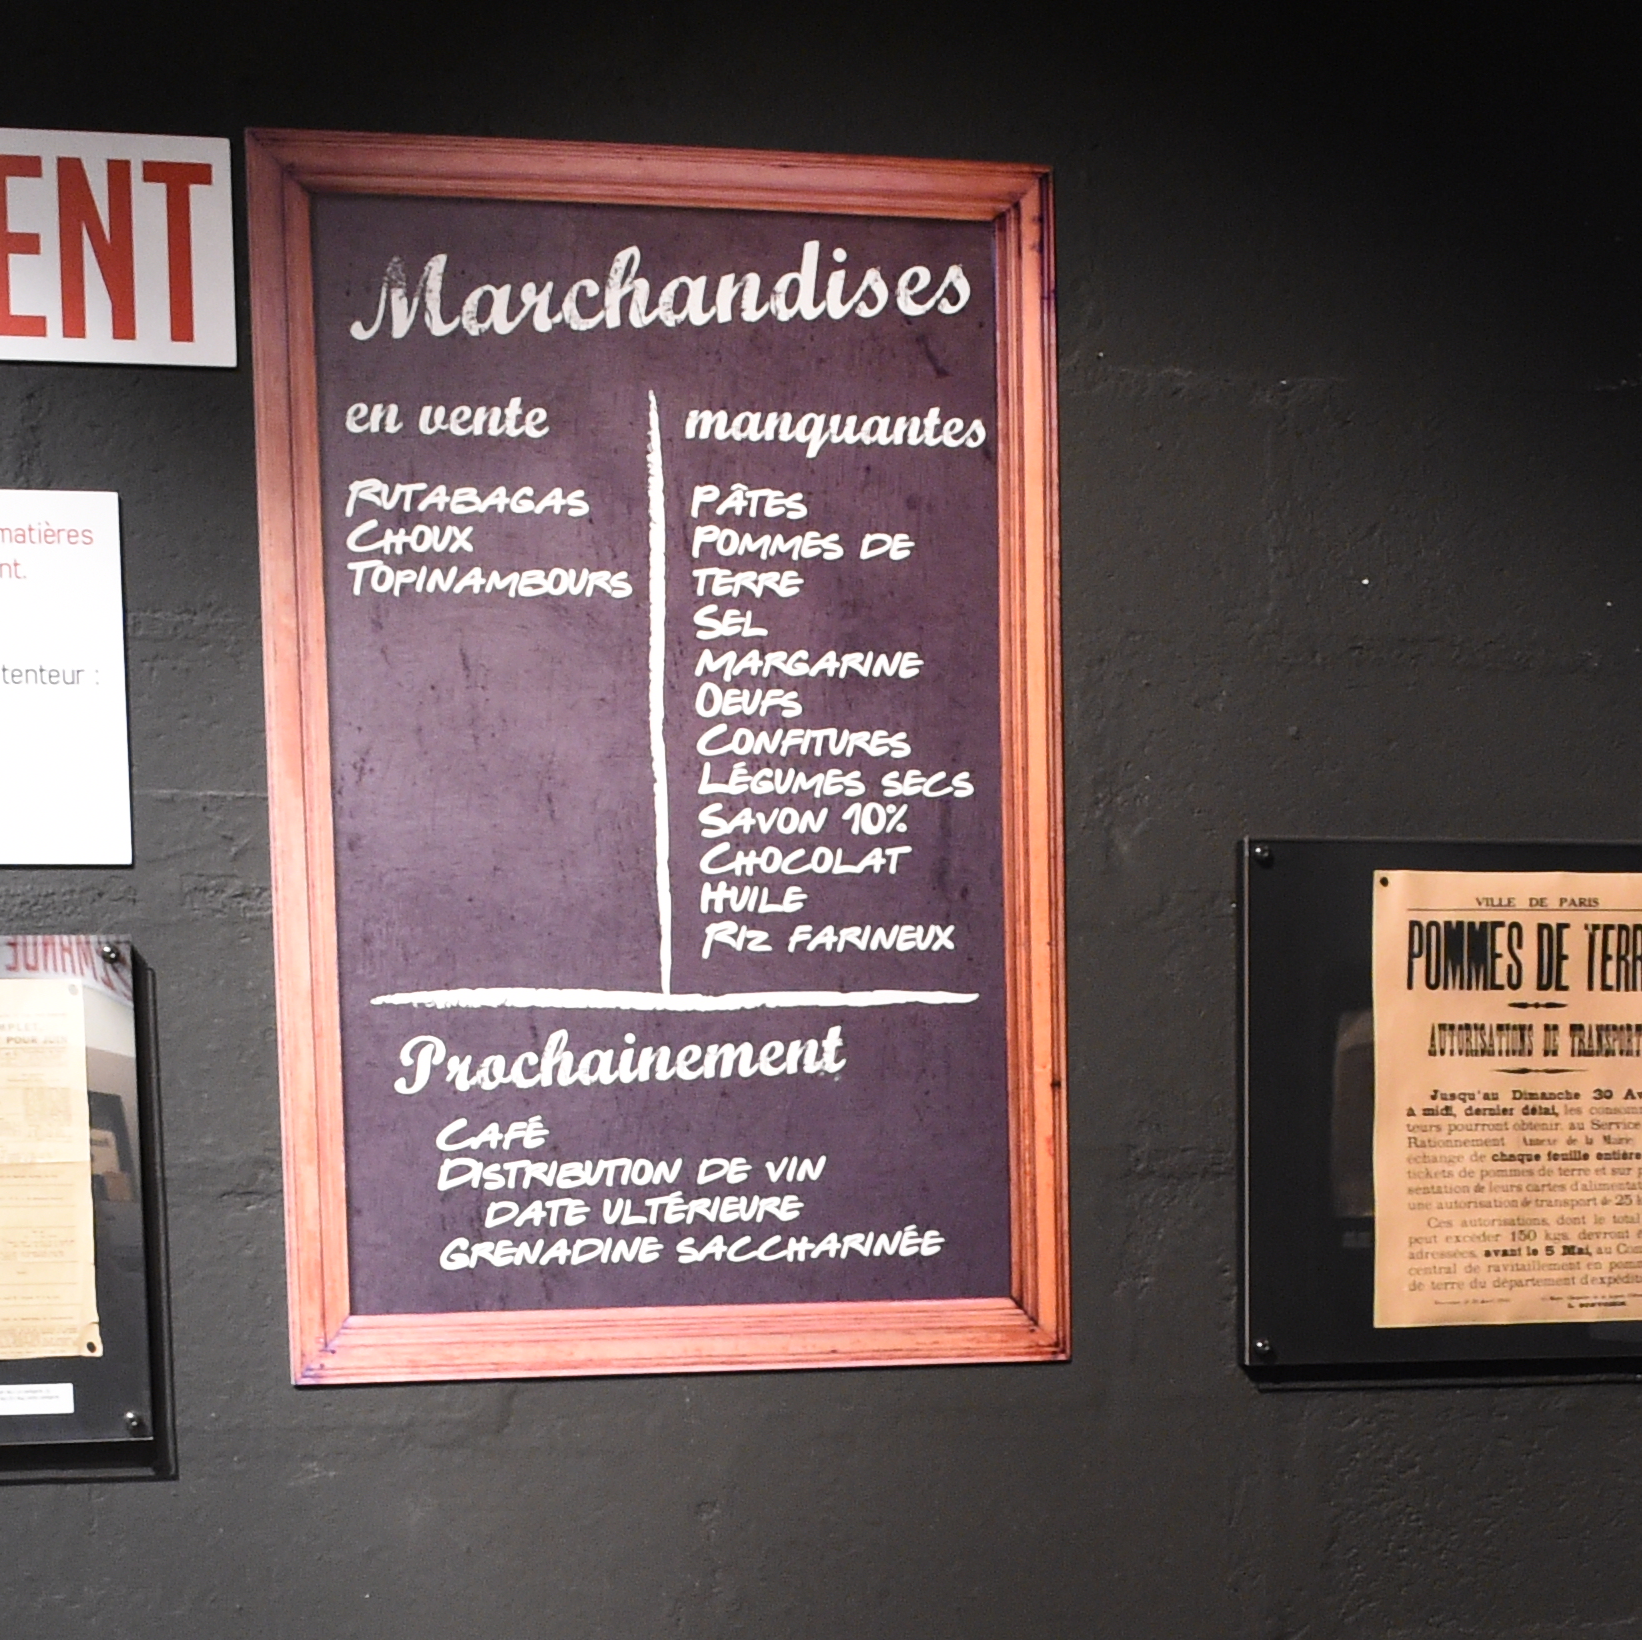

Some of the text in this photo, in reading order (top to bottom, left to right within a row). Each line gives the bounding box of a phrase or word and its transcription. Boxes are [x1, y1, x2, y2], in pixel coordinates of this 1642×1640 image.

[350, 241, 970, 340] Marchandises
[346, 397, 549, 438] en vente
[685, 407, 986, 458] manquantes
[346, 479, 589, 517] RUTABAGAS
[691, 483, 807, 519] PÂTES
[347, 519, 473, 555] CHOUX
[692, 525, 916, 560] POMMES DE
[347, 560, 632, 598] TOPINAMBOURS
[692, 567, 804, 598] TERRE
[694, 604, 768, 640] SEL
[695, 649, 924, 682] MARGARINE
[695, 682, 802, 718] OEUFS
[697, 723, 911, 758] CONFITURES
[698, 762, 974, 798] LÉGUMES SECS
[698, 802, 908, 838] SAVON 10%
[700, 842, 912, 876] CHOCOLAT
[700, 886, 807, 914] HUILE
[1475, 897, 1599, 908] VILLE DE PARIS
[702, 921, 954, 959] RIZ FARINEUX
[1407, 920, 1523, 991] POMMES
[1537, 923, 1570, 991] DE
[1428, 1023, 1642, 1057] AUTORISATIONS DE TRANSPORT
[394, 1026, 846, 1094] Prochainement
[1430, 1089, 1499, 1103] Jusqu'au
[1512, 1090, 1580, 1100] Dimanche
[1593, 1089, 1613, 1100] 30
[1464, 1105, 1514, 1116] dernier
[436, 1115, 549, 1151] CAFÉ
[438, 1155, 826, 1191] DISTRIBUTION DE VIN
[485, 1191, 804, 1228] DATE ULTÉRIEURE
[440, 1225, 945, 1270] GRENADINE SACCHARINÉE
